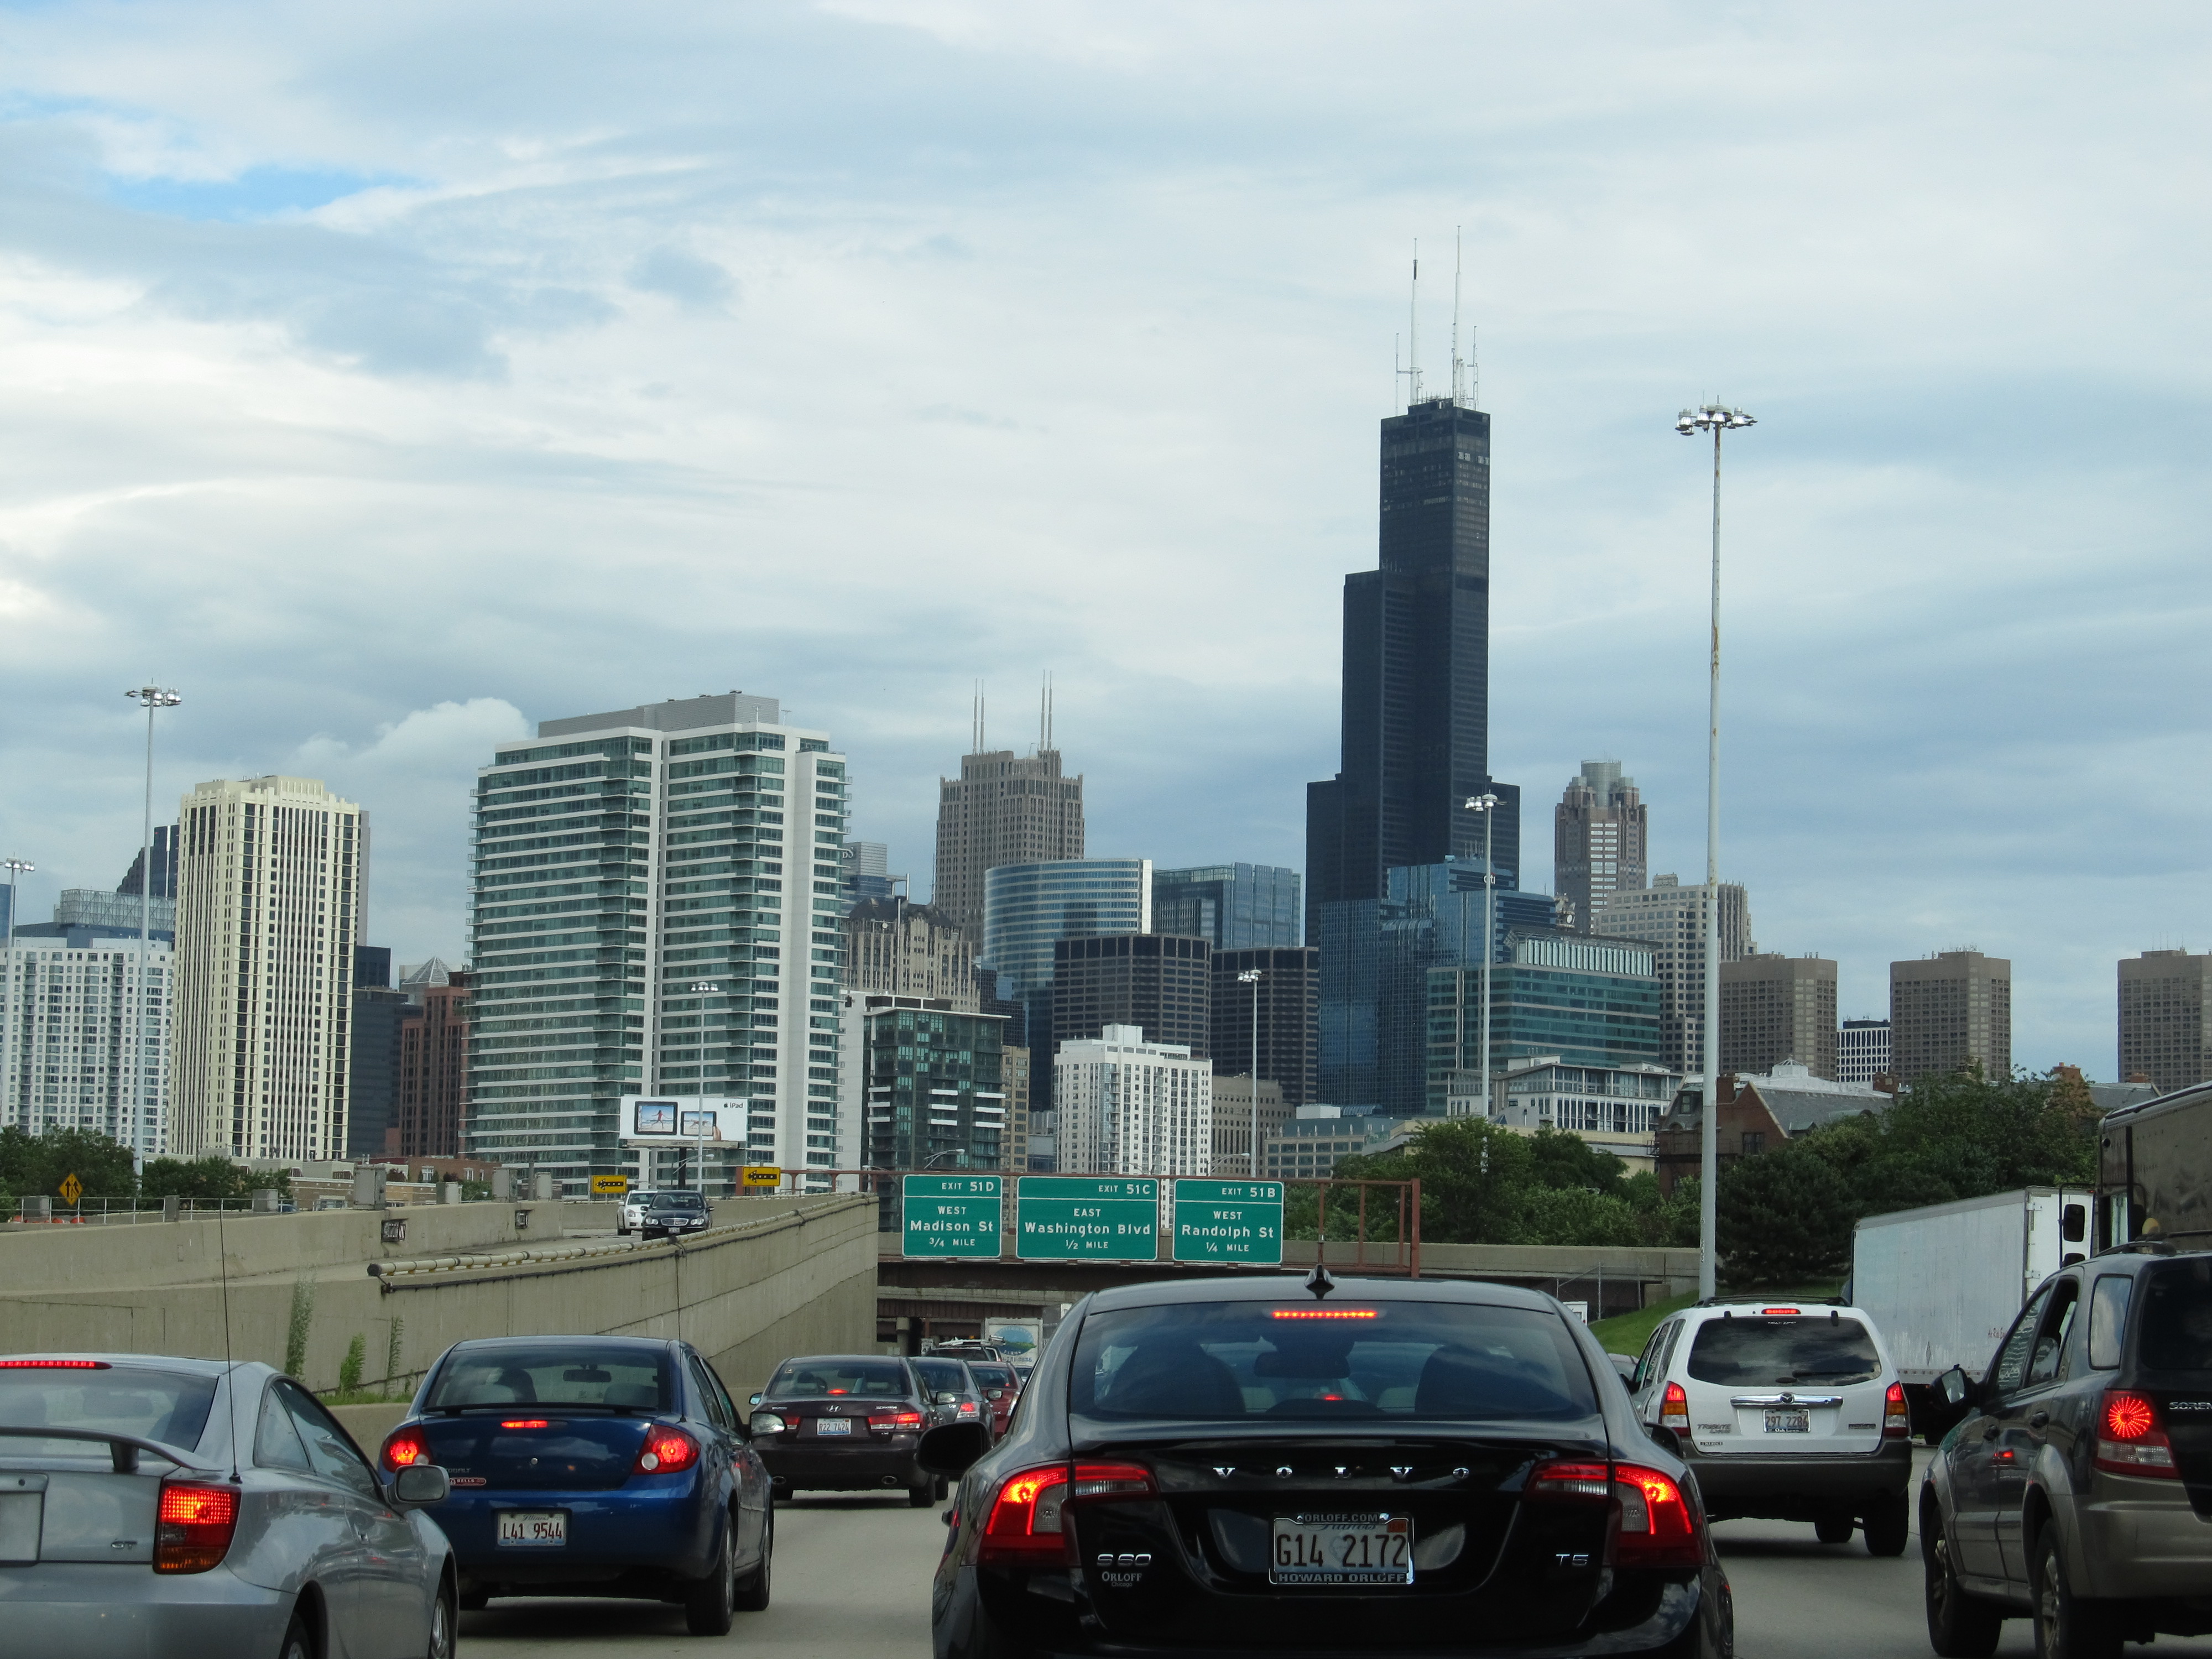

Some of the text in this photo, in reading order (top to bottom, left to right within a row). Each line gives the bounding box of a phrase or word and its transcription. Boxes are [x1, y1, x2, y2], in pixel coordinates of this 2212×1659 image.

[969, 1181, 994, 1192] 51D
[1126, 1184, 1151, 1194] 51C
[1250, 1187, 1275, 1198] 51B
[938, 1206, 967, 1214] WEST
[1073, 1208, 1101, 1217] EAST
[1213, 1211, 1243, 1220] WEST
[910, 1220, 993, 1232] Madison St
[1025, 1222, 1151, 1238] Washington Blvd
[1182, 1224, 1274, 1239] Randolph St
[929, 1238, 945, 1248] 3/4
[1065, 1239, 1078, 1250] 1/2
[1206, 1242, 1218, 1252] 1/4
[1766, 1416, 1781, 1427] 297
[1212, 1467, 1470, 1479] VOLVO
[503, 1522, 562, 1539] L41 9544
[111, 1541, 137, 1549] GT
[1276, 1534, 1407, 1568] G14 2172
[1556, 1554, 1589, 1566] T5
[1102, 1572, 1142, 1582] ORLOFF
[1278, 1574, 1405, 1582] HOWARD ORLOFF
